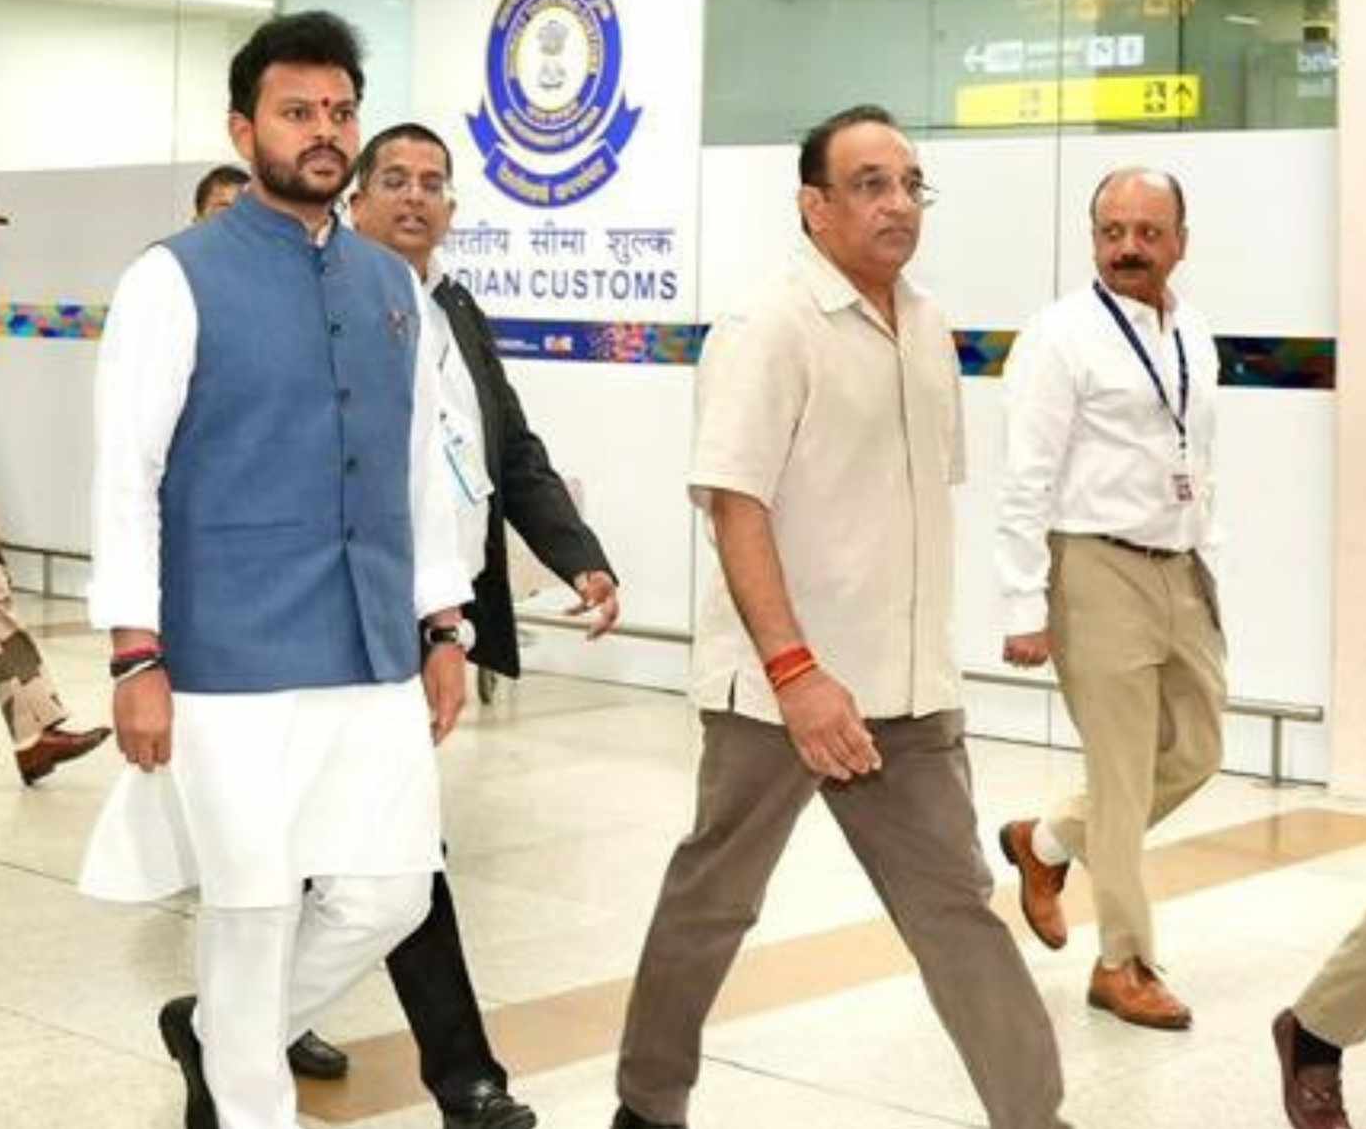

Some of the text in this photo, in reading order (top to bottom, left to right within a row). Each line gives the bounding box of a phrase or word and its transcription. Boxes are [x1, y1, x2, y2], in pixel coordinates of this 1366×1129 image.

[528, 220, 587, 257] सीमा
[606, 227, 675, 266] शुल्क
[528, 268, 679, 301] CUSTOMS
